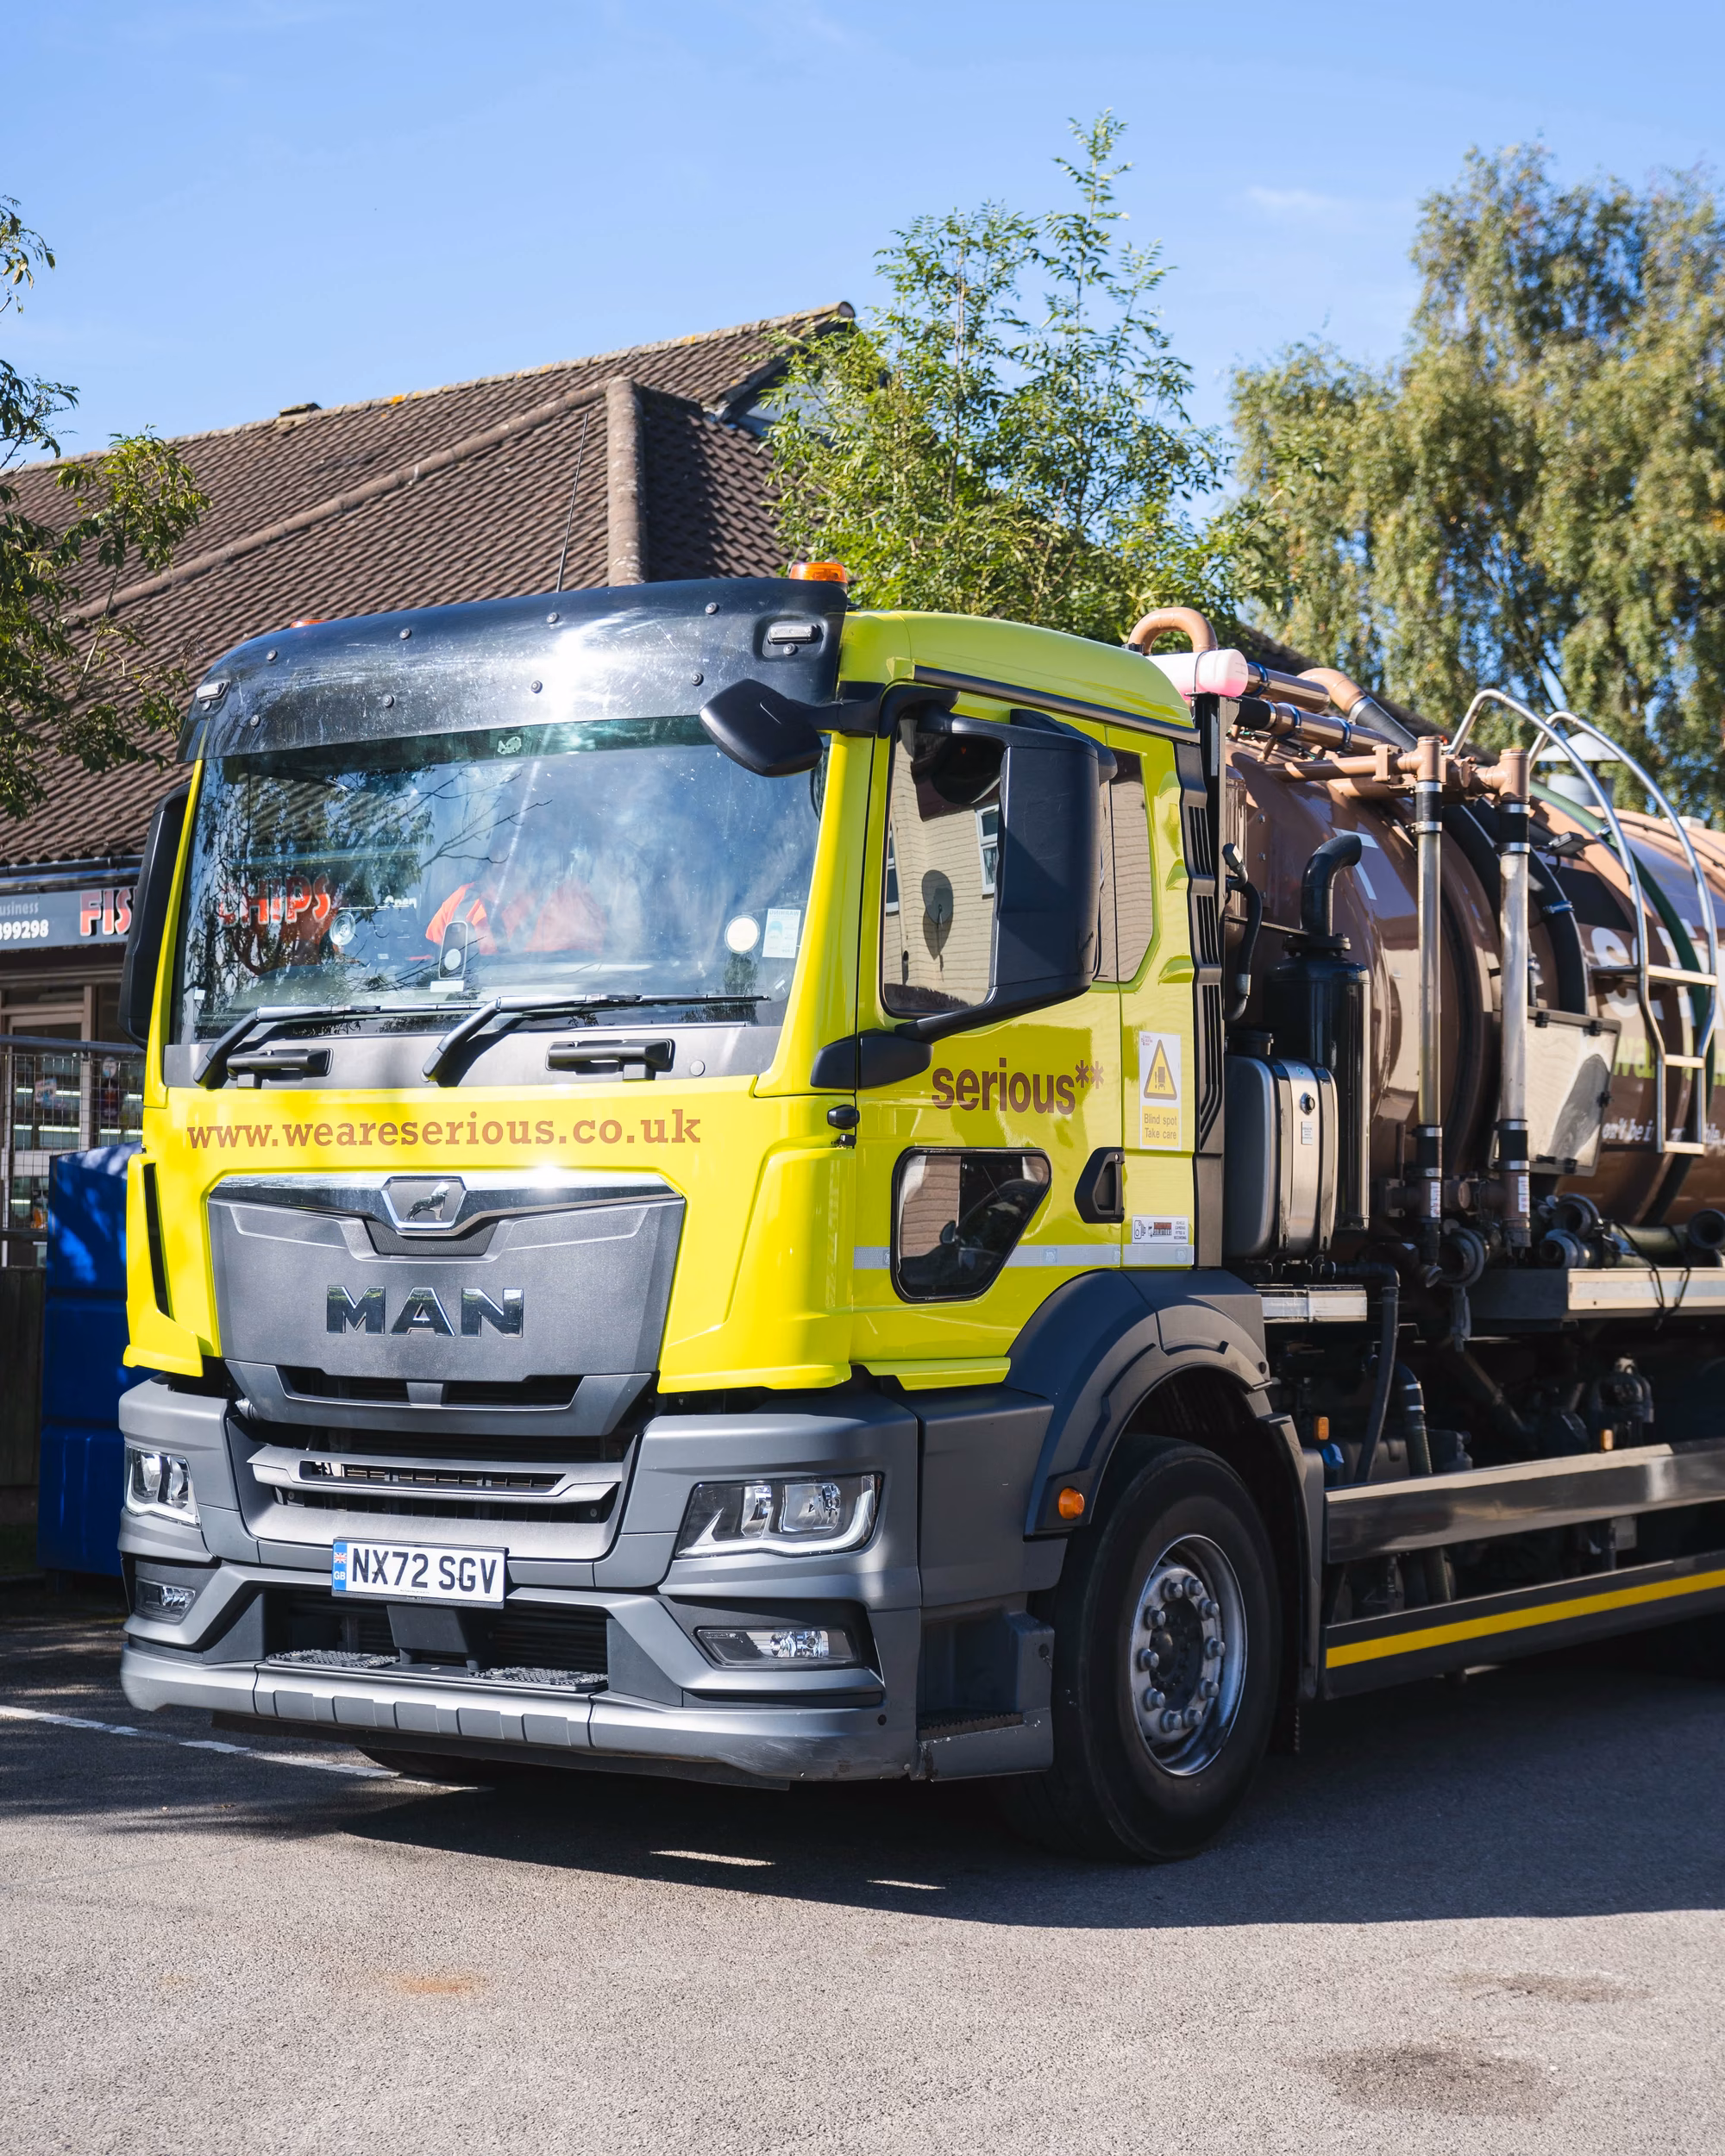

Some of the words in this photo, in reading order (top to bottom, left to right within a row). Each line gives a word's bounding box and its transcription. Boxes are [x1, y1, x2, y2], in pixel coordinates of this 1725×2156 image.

[79, 887, 138, 937] FIS
[187, 1108, 701, 1149] www.weareserious.co.uk
[1144, 1113, 1161, 1125] Blind
[1163, 1116, 1177, 1126] spot
[1145, 1127, 1160, 1138] Take
[1163, 1129, 1177, 1139] care
[325, 1285, 524, 1338] MAN
[334, 1570, 346, 1580] GB
[352, 1547, 429, 1589] NX72
[438, 1555, 498, 1594] SGV
